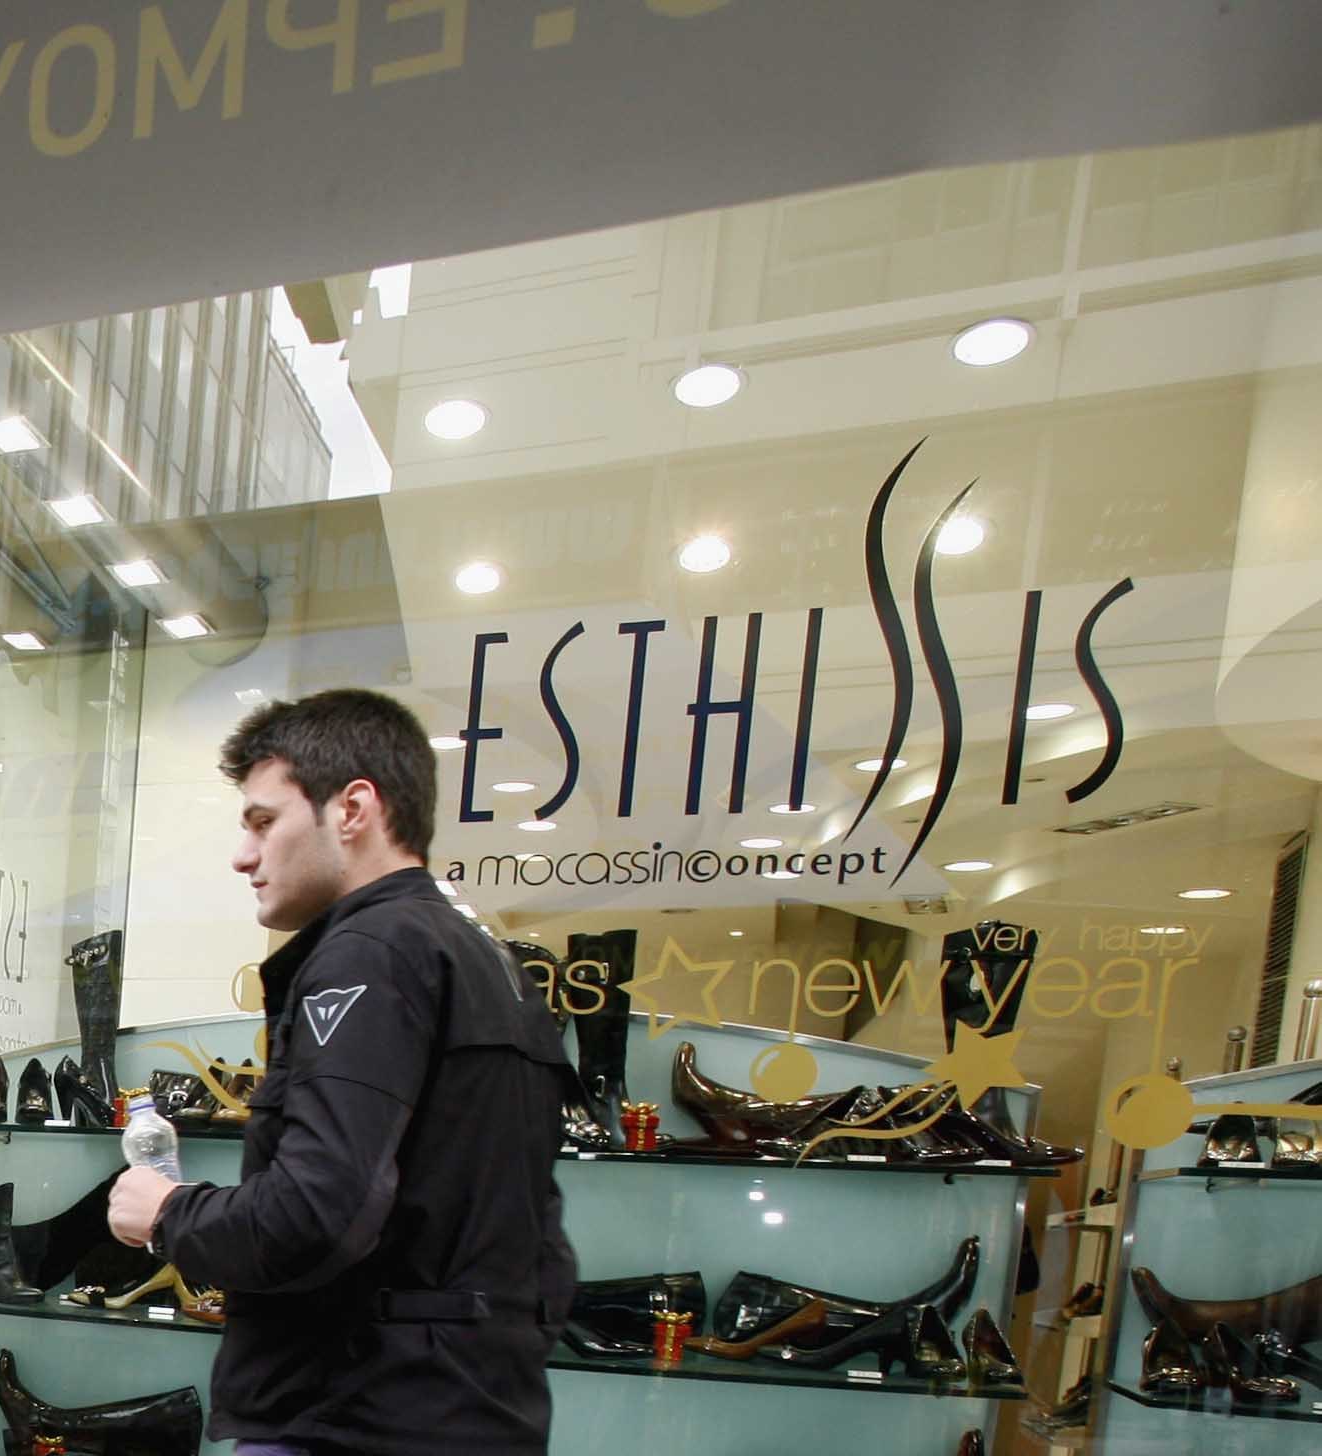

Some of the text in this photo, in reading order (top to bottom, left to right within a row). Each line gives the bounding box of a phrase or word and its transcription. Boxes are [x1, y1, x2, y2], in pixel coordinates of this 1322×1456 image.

[458, 434, 1134, 891] ESTHISSIS
[446, 861, 466, 882] a
[970, 917, 1214, 959] very happy
[748, 957, 951, 1032] new
[969, 956, 1201, 1034] year
